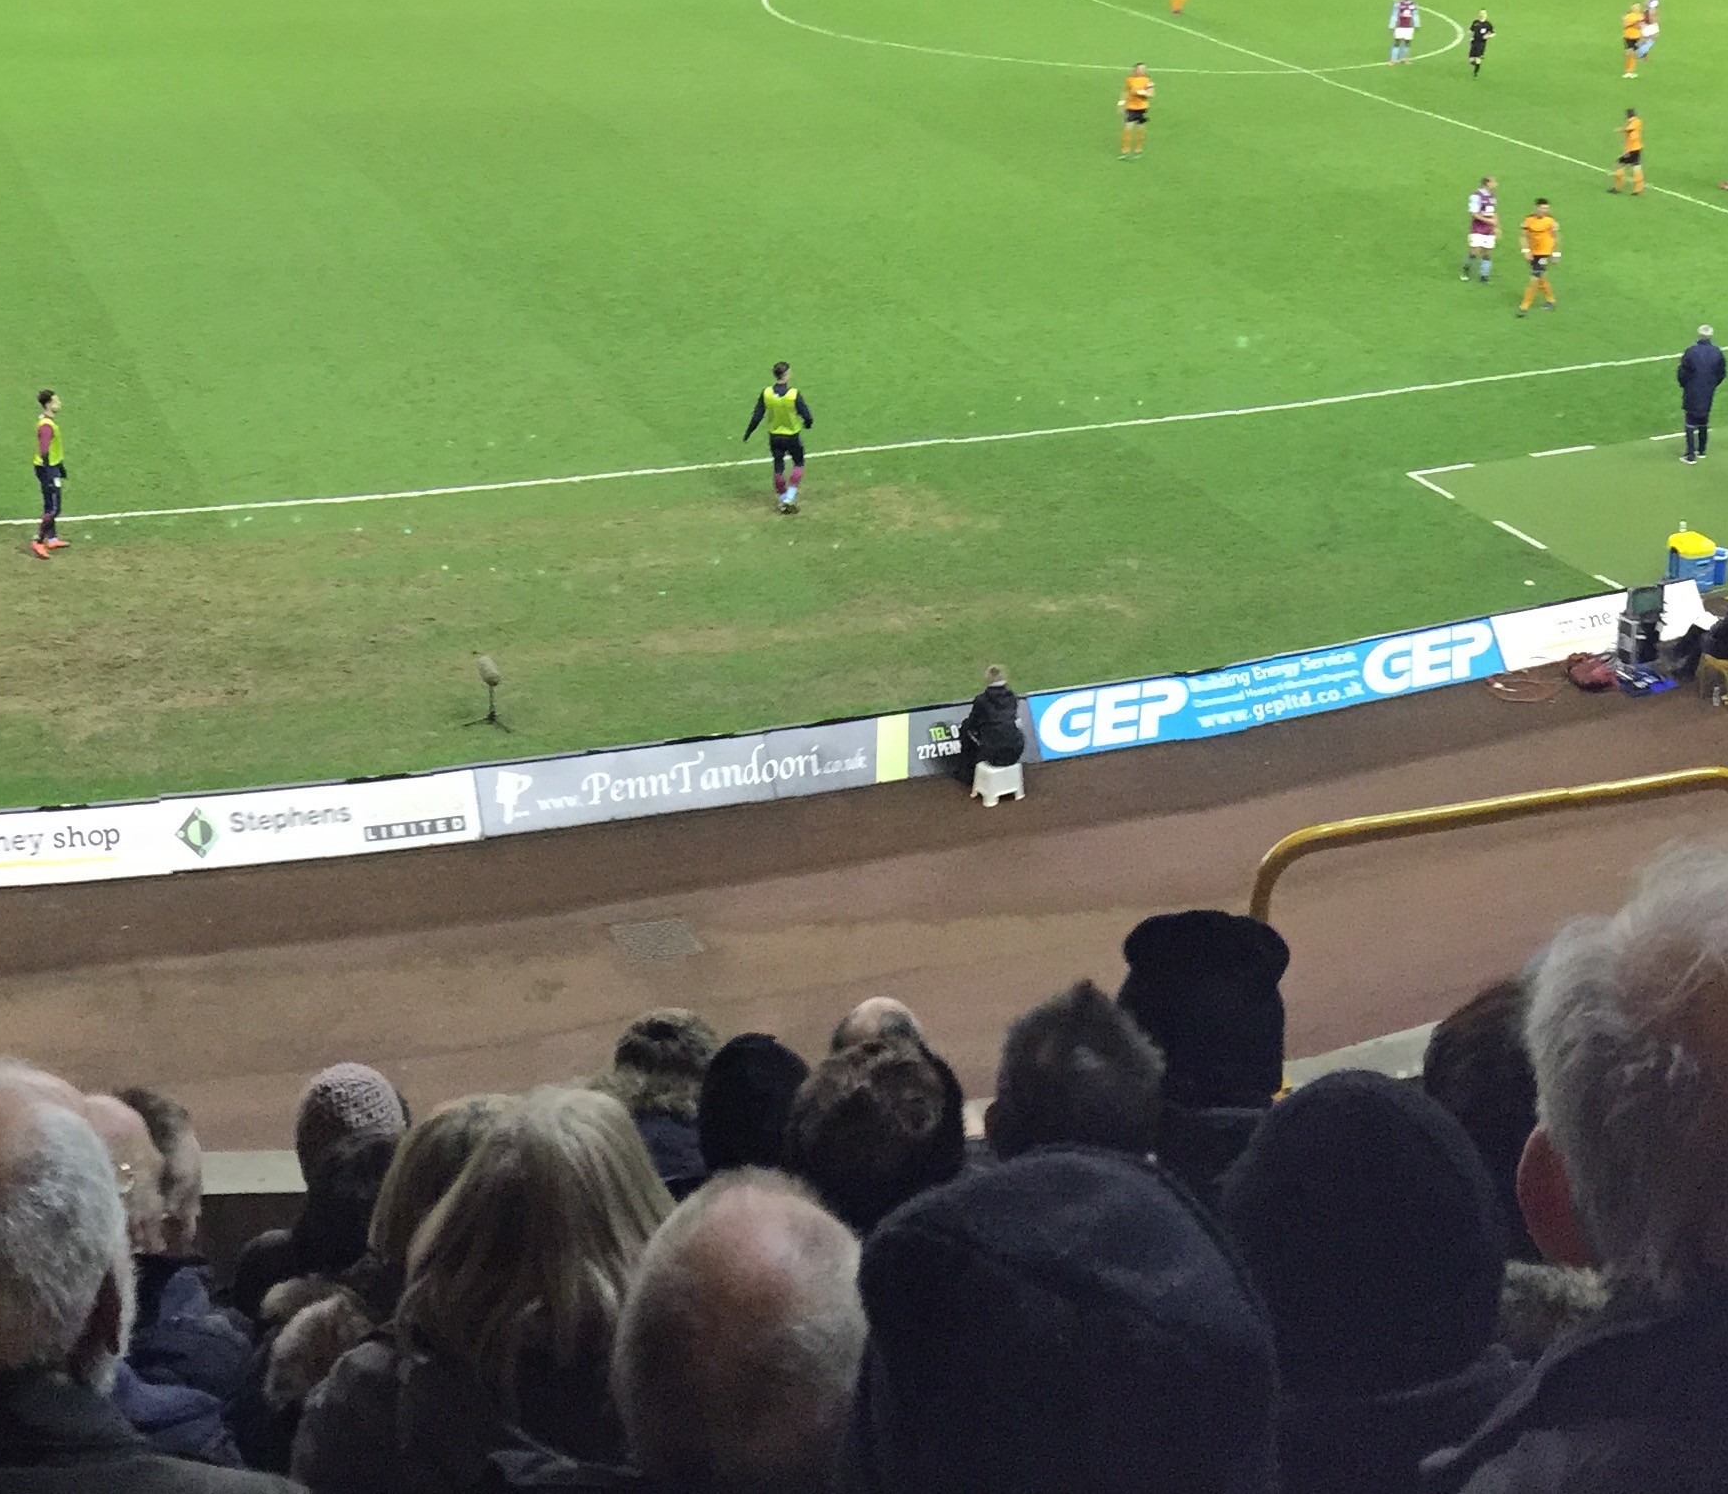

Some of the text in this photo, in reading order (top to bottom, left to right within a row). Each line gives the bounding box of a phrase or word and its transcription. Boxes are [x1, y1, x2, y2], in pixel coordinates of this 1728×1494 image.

[1251, 661, 1301, 682] Energy
[1362, 621, 1494, 695] GEP
[1038, 677, 1189, 754] GEP
[1196, 680, 1365, 729] www.gepltd.co.uk
[916, 743, 938, 760] 272
[230, 805, 352, 835] Stephens
[365, 816, 466, 842] LIMITED
[52, 825, 122, 854] shop
